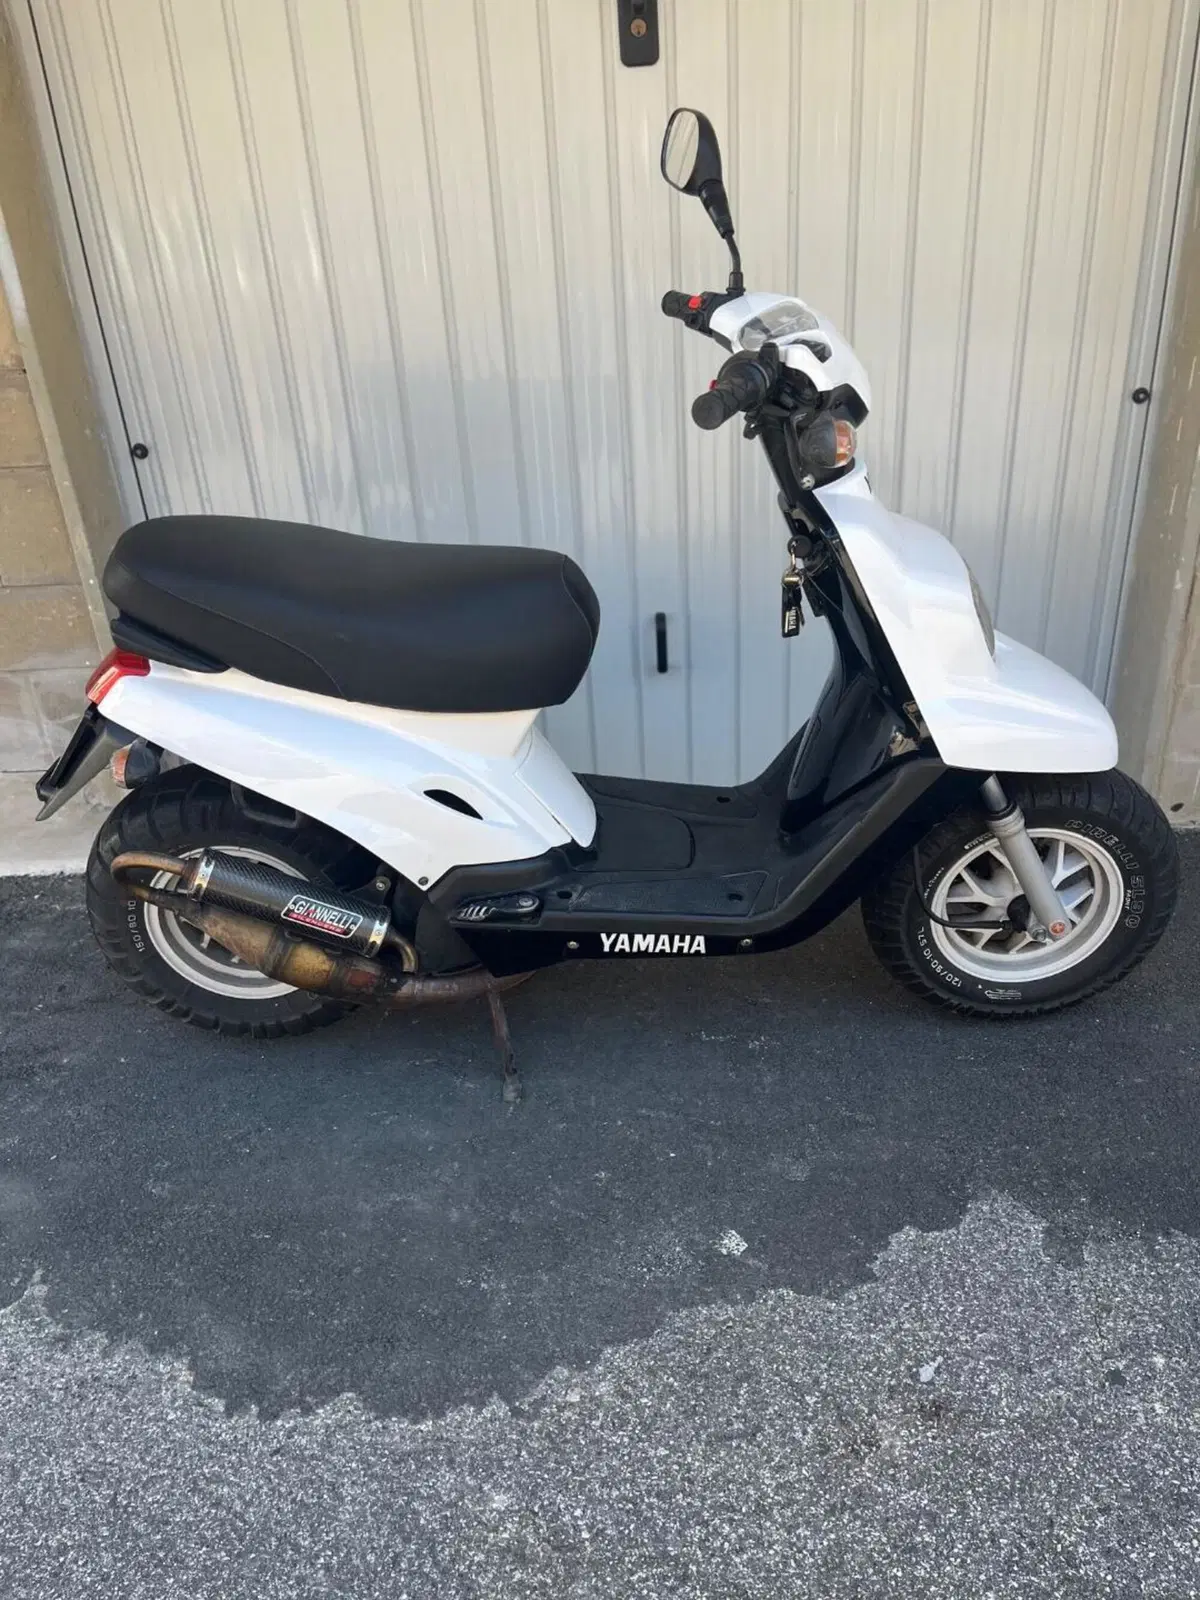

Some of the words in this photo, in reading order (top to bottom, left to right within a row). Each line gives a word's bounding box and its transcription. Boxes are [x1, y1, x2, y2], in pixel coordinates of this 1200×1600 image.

[1065, 819, 1139, 870] PIRELLI
[294, 900, 354, 929] GIANNELLI
[127, 914, 146, 952] 150/80
[600, 932, 706, 954] YAMAHA
[917, 926, 927, 947] 57L
[923, 948, 963, 988] 120/90-10
